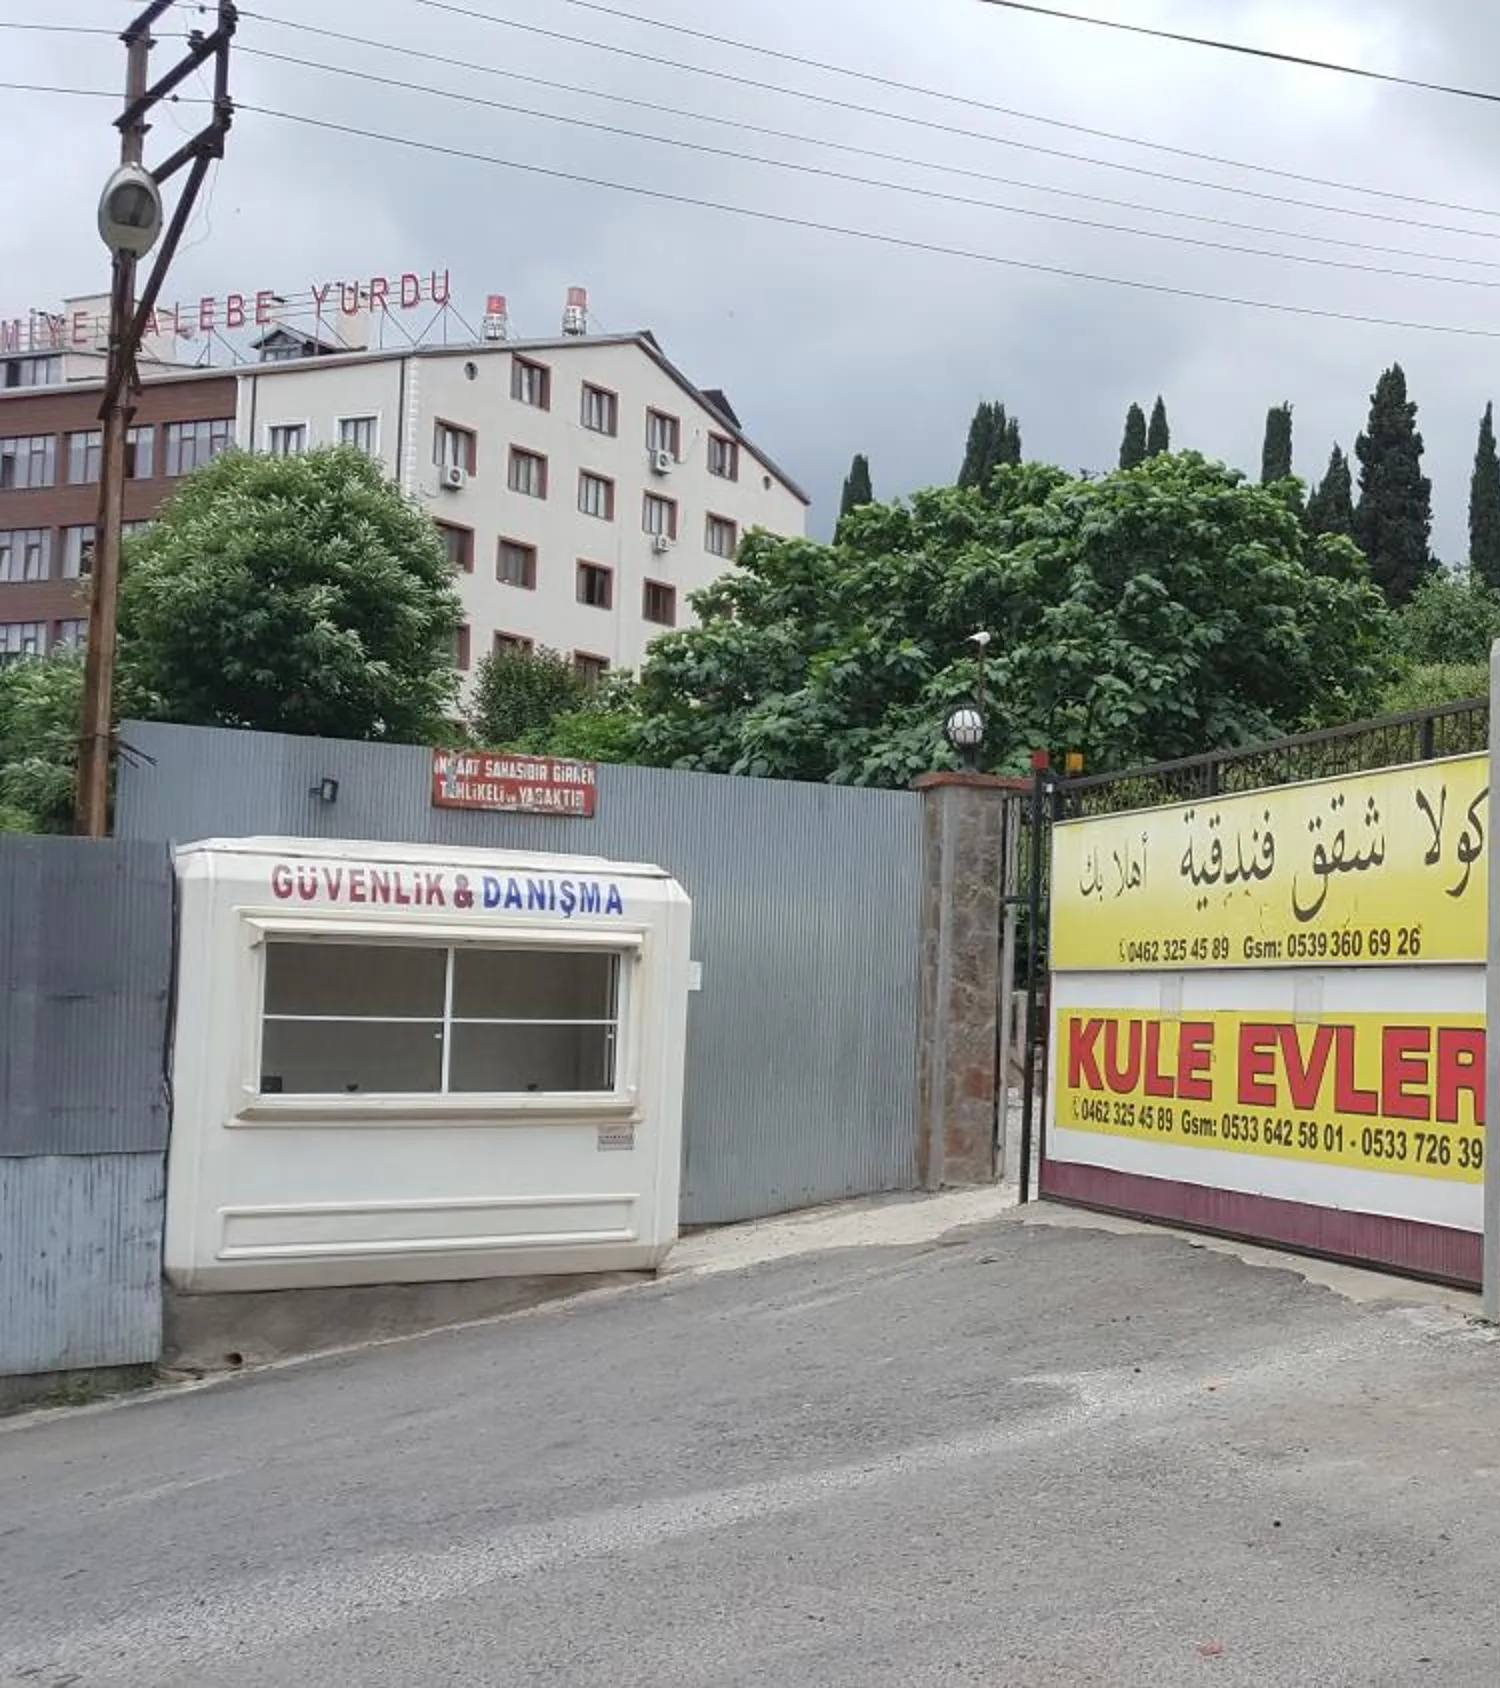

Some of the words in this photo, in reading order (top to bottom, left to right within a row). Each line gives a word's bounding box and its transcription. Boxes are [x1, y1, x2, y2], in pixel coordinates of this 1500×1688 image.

[145, 290, 274, 336] ALEBE
[311, 270, 450, 318] YURDU
[485, 759, 548, 781] SAHASIDIR
[272, 864, 446, 906] GÜVENLİK
[454, 874, 475, 909] &
[483, 876, 624, 918] DANIŞMA
[1180, 809, 1275, 912] فندقية
[1291, 793, 1386, 923] شقق
[1128, 941, 1159, 962] 0462
[1163, 939, 1187, 961] 325
[1191, 937, 1208, 960] 45
[1212, 937, 1229, 960] 89
[1243, 935, 1282, 960] Gsm:
[1287, 932, 1328, 958] 0539
[1330, 929, 1363, 957] 360
[1369, 928, 1391, 956] 69
[1397, 927, 1421, 956] 26
[1068, 1017, 1215, 1101] KULE
[1237, 1021, 1486, 1126] EVLER
[1081, 1098, 1110, 1124] 0462
[1113, 1102, 1135, 1127] 325
[1138, 1105, 1153, 1130] 45
[1157, 1107, 1173, 1132] 89
[1181, 1109, 1217, 1137] Gsm:
[1221, 1113, 1259, 1143] 0533
[1264, 1117, 1293, 1147] 642
[1298, 1121, 1319, 1150] 58
[1323, 1123, 1344, 1153] 01
[1361, 1128, 1407, 1162] 0533
[1414, 1132, 1451, 1166] 726
[1457, 1136, 1483, 1170] 39
